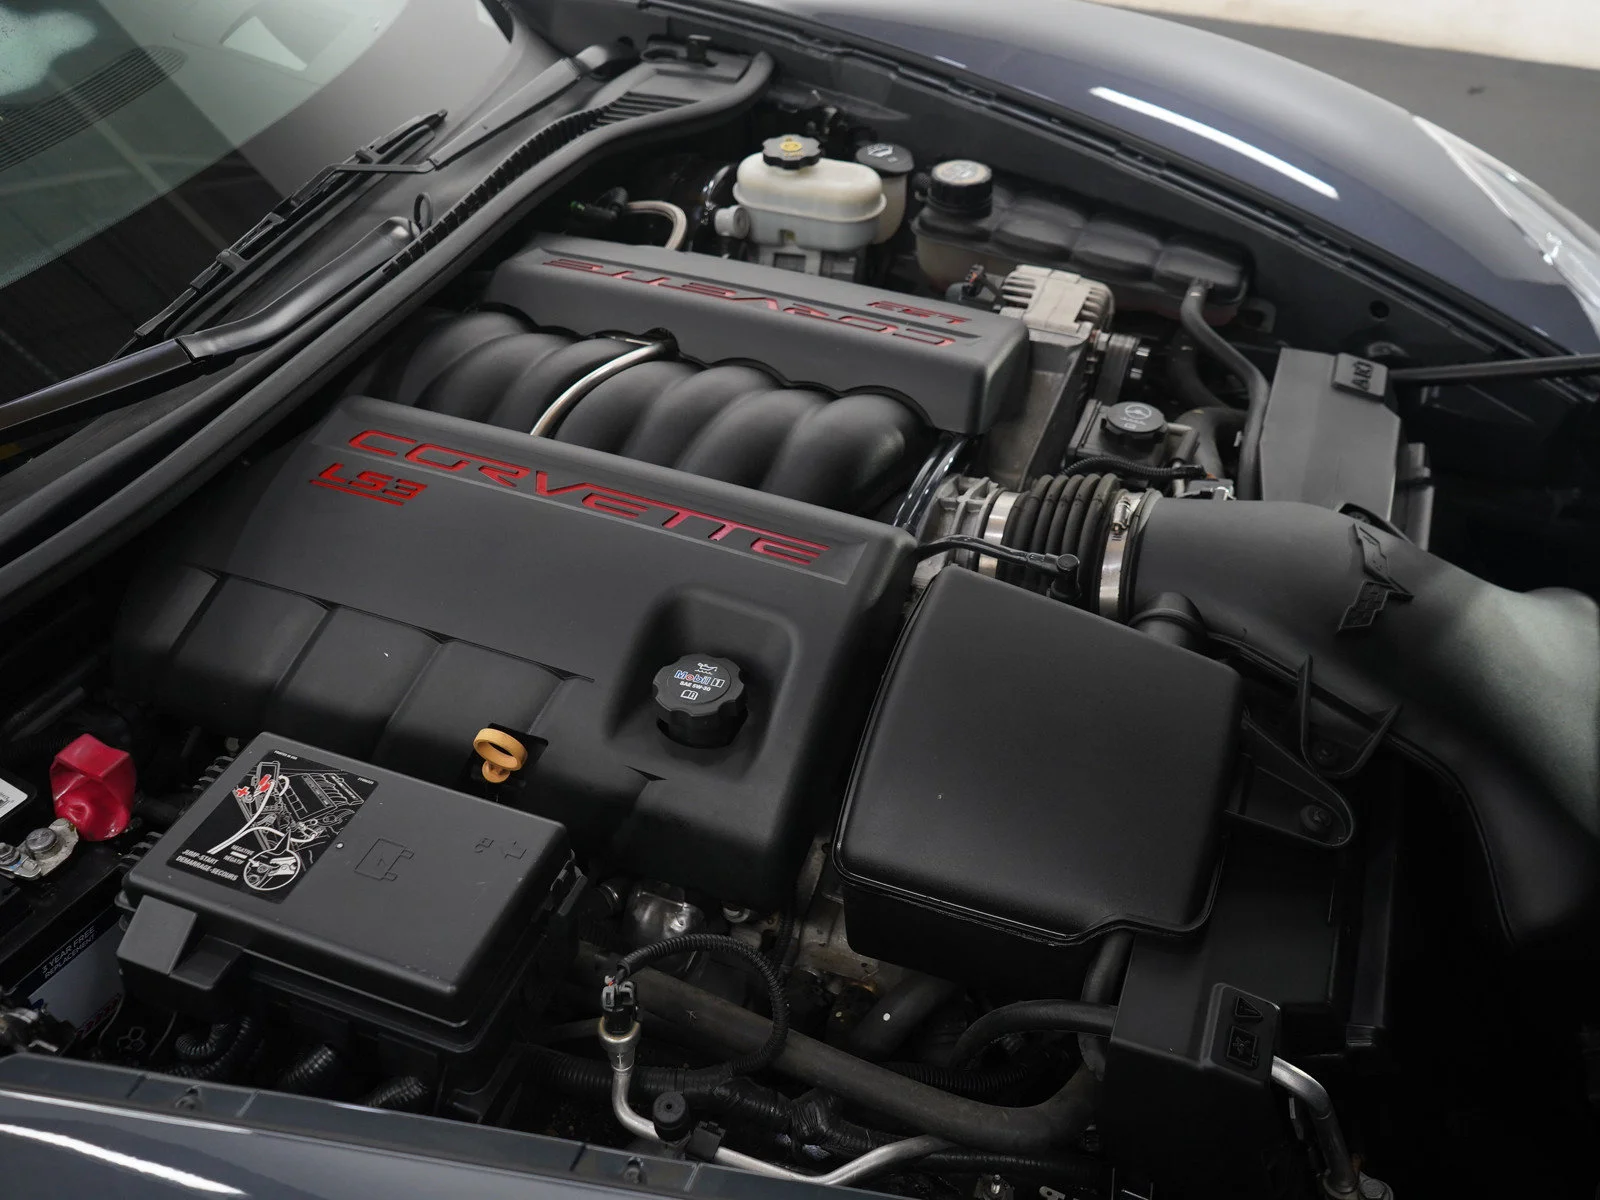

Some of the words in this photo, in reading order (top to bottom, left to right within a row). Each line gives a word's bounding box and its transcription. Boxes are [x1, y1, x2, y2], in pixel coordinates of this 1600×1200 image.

[542, 257, 957, 347] CORVETTE
[309, 461, 428, 505] LS3
[347, 429, 830, 565] CORVETTE
[674, 669, 711, 685] Mobil
[182, 849, 219, 865] JUMP-START
[231, 844, 255, 856] NEGATIVE
[44, 932, 95, 979] REPLACEMENT
[49, 945, 72, 966] YEAR
[73, 925, 95, 947] FREE
